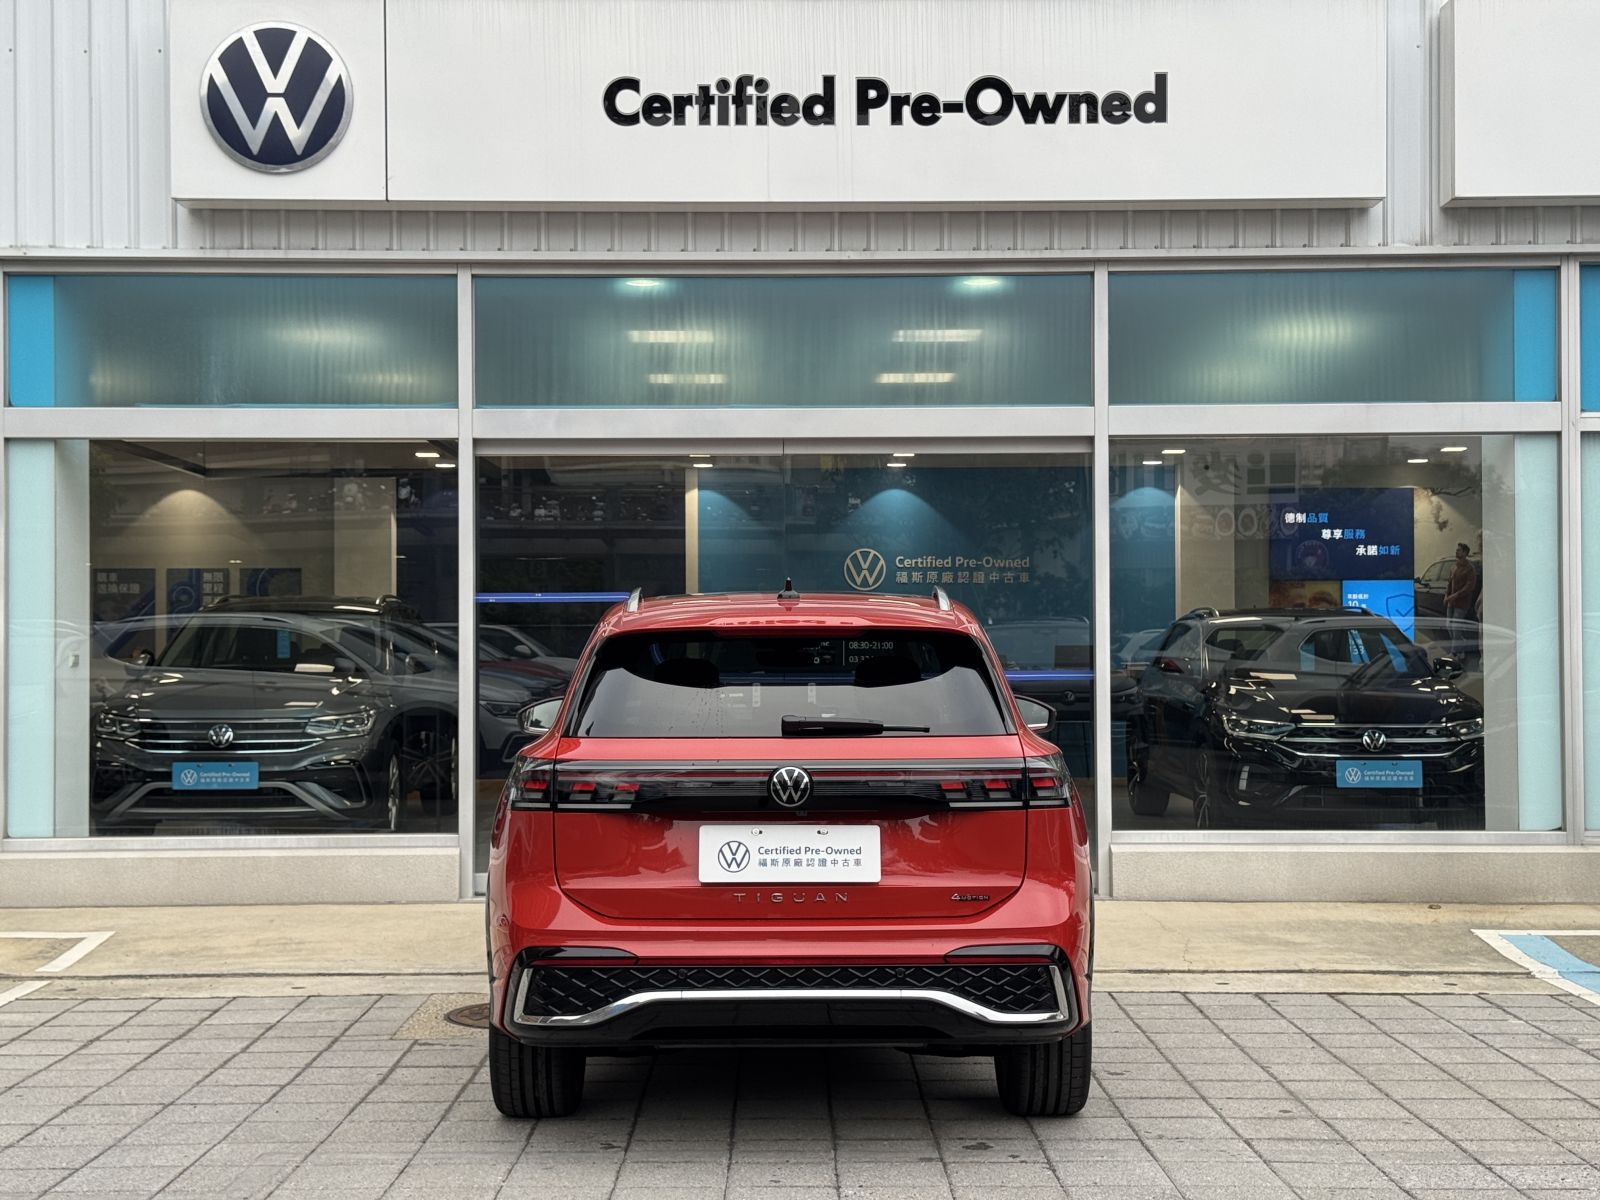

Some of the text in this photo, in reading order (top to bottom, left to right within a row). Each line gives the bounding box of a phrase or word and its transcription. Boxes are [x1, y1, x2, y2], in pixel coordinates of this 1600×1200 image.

[602, 71, 1169, 127] Certified Pre-Owned
[1321, 528, 1366, 541] 尊享服務
[1355, 544, 1400, 556] 承諾如新
[895, 555, 1030, 568] Certified Pre-Owned
[895, 571, 1030, 584] 福斯原廠認證中古車
[848, 640, 894, 650] 08:30-21:00
[757, 845, 862, 855] Certified Pre-Owned
[758, 857, 862, 868] 福斯原廠認證中古車
[732, 892, 849, 903] TIGUAN
